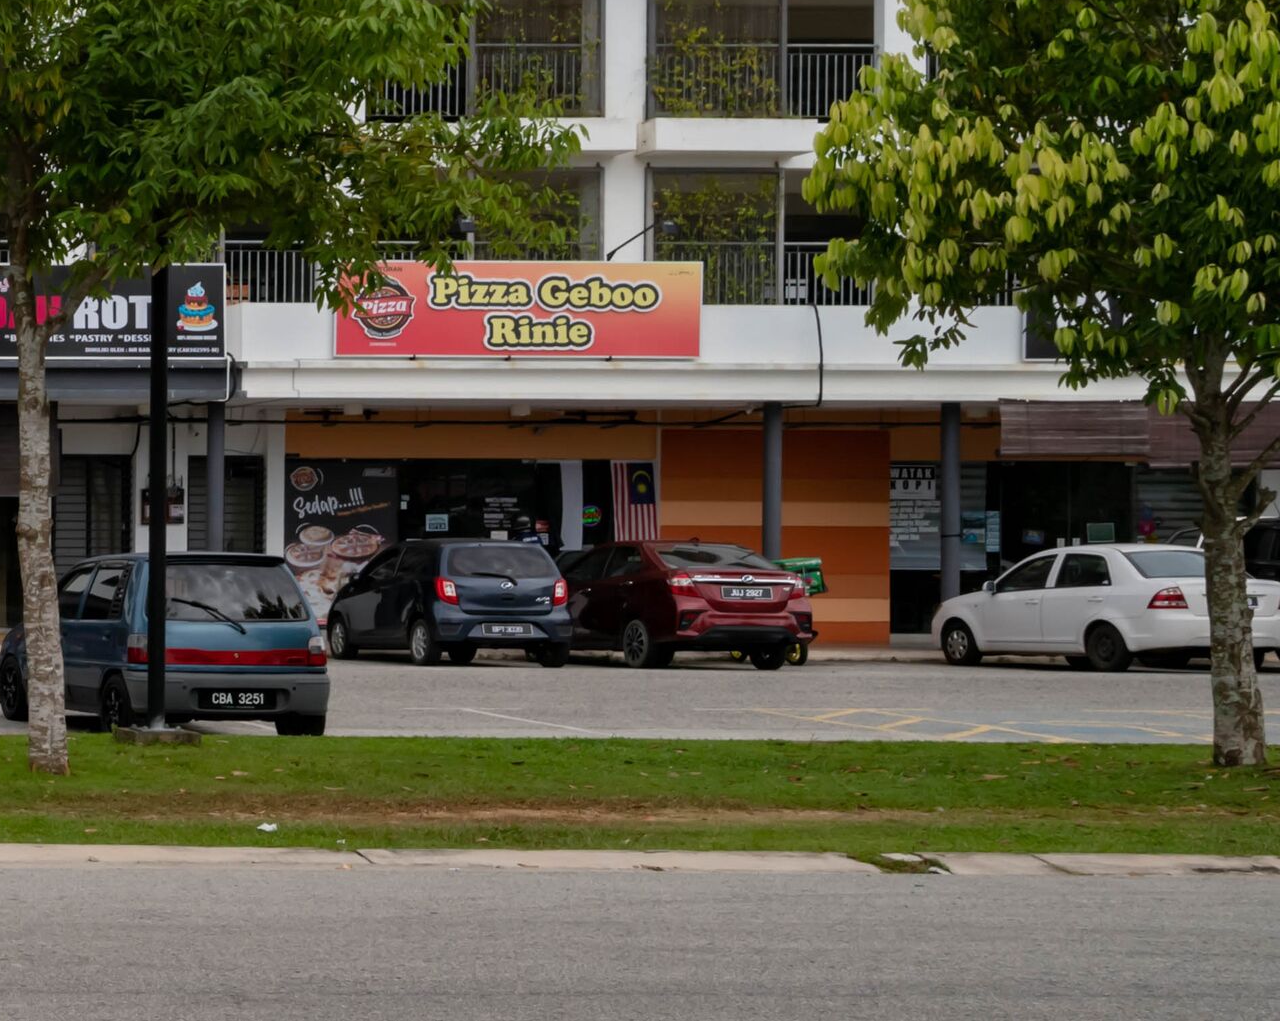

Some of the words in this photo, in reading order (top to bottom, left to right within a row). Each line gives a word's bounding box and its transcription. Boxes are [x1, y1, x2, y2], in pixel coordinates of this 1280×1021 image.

[431, 275, 532, 308] Pizza
[538, 275, 660, 308] Geboo
[73, 295, 152, 329] ROT
[487, 315, 592, 346] Rinie
[211, 692, 233, 705] CBA
[238, 692, 265, 705] 3251
